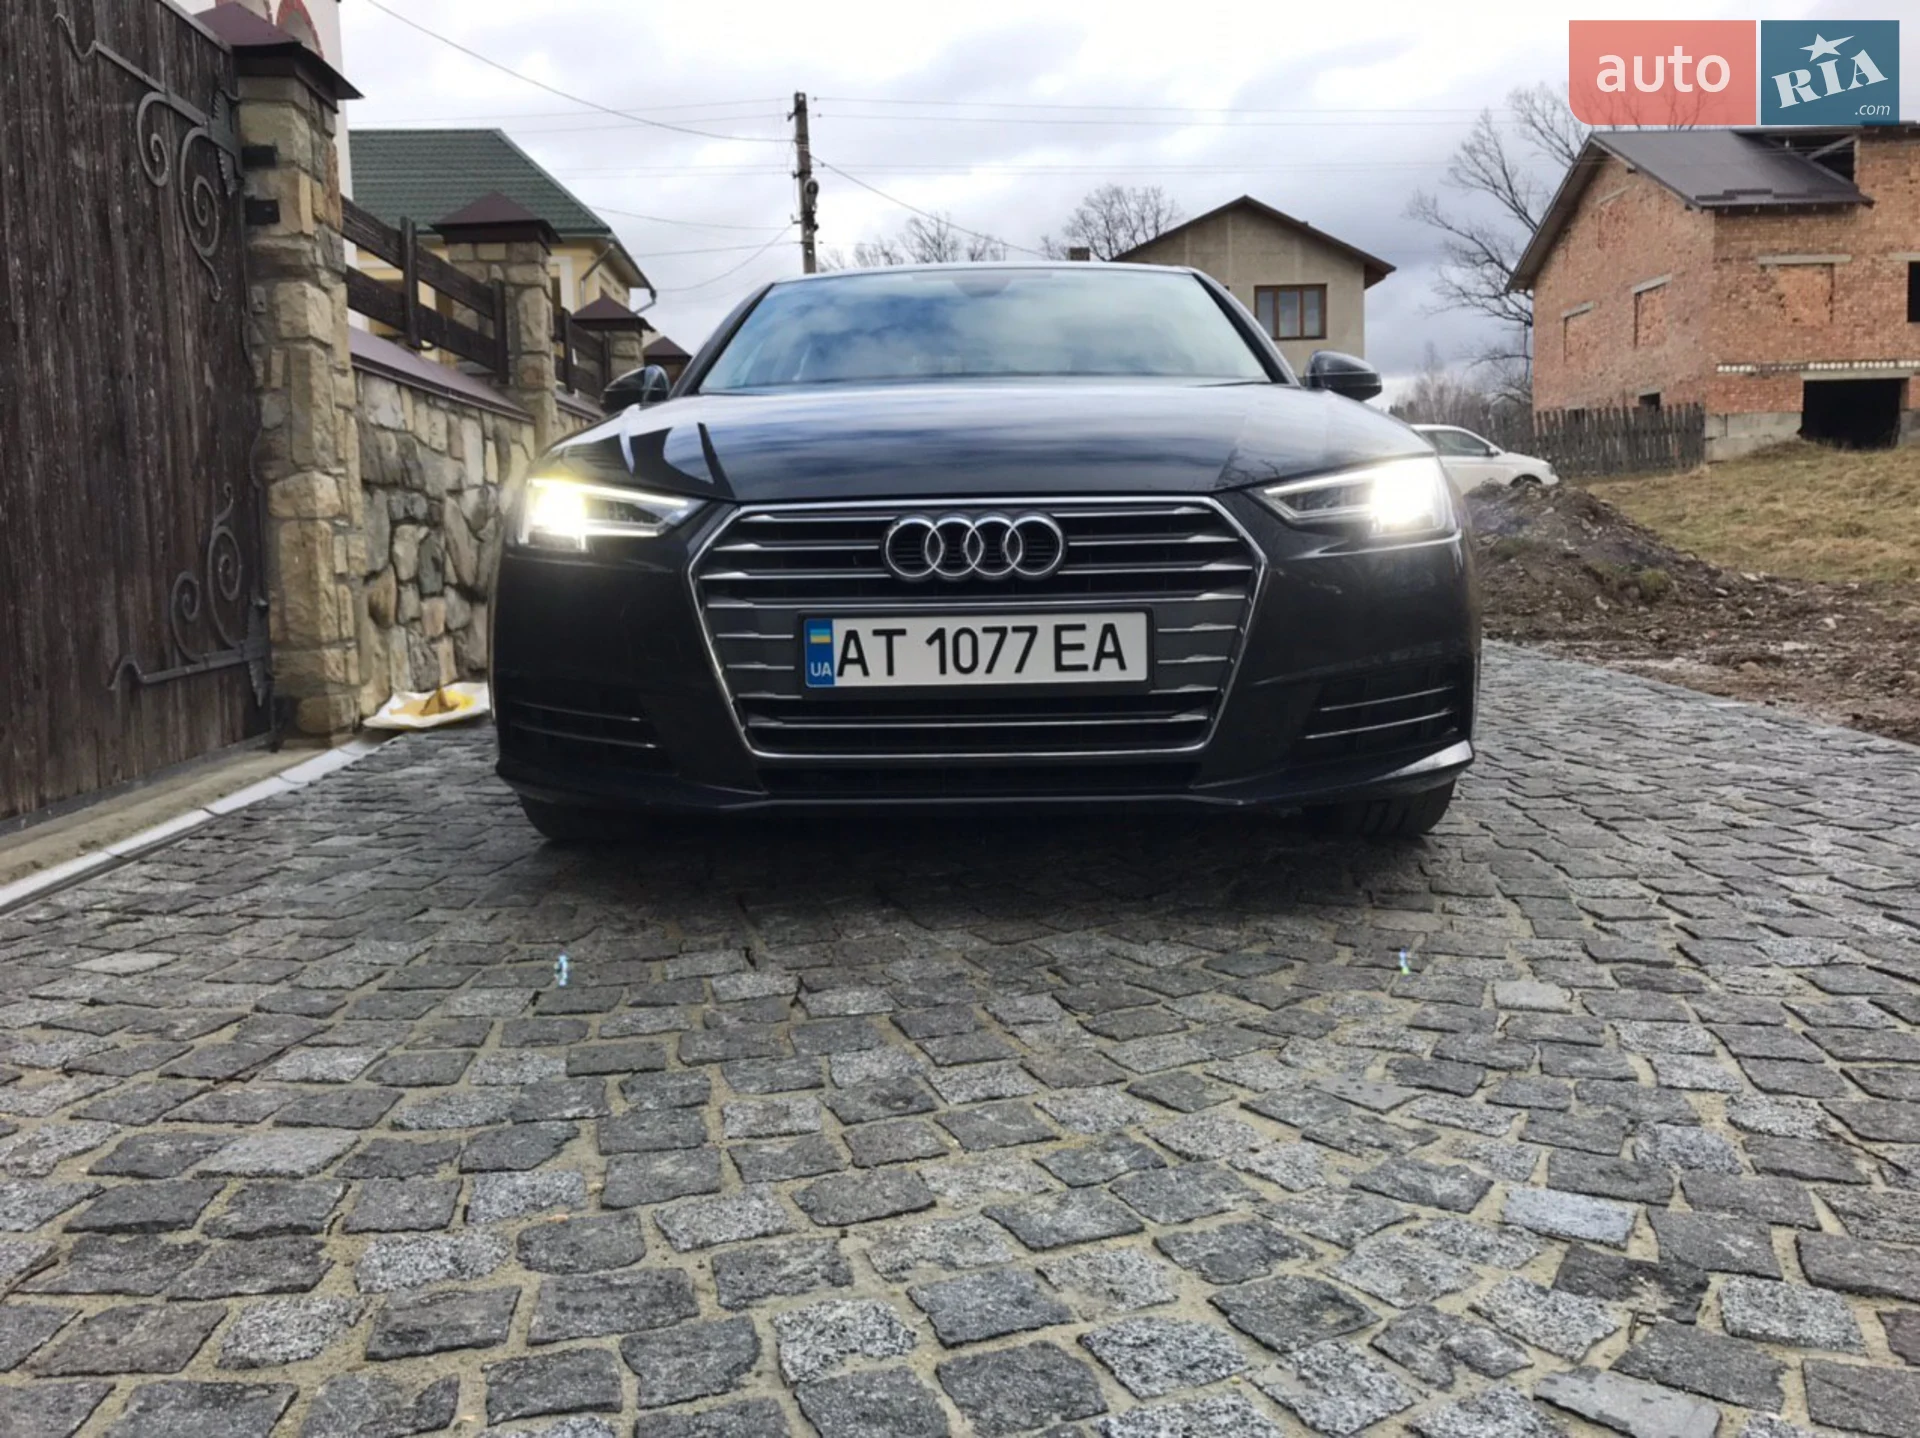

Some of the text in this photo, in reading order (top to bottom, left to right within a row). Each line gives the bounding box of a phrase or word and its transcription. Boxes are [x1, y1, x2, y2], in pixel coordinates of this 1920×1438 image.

[836, 623, 1127, 677] AT 1077 EA
[810, 661, 832, 677] UA
